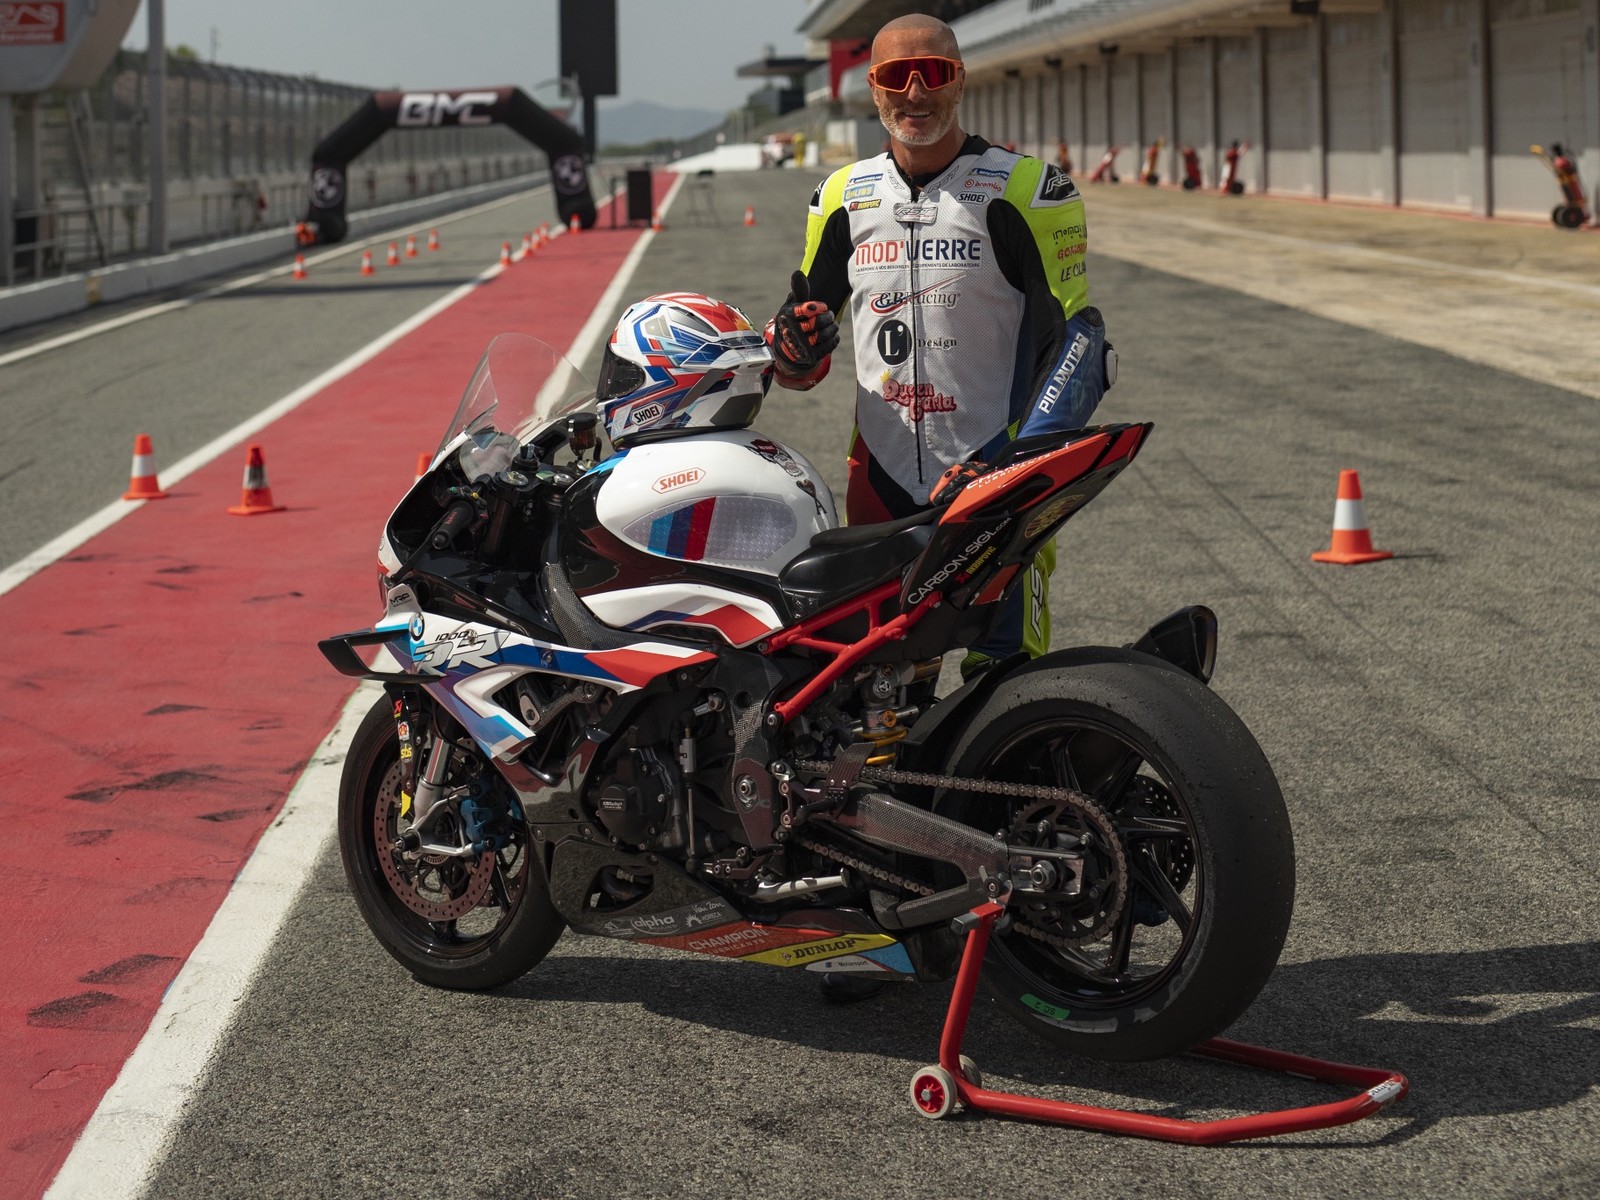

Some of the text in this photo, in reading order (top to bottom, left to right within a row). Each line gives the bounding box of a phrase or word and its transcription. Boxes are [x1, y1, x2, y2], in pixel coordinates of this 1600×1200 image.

[397, 92, 498, 125] BMC
[1044, 172, 1072, 195] RS
[958, 193, 985, 203] SHOEI
[918, 338, 957, 349] Design
[633, 405, 661, 424] SHOEI
[659, 469, 699, 491] SHOEI
[1029, 551, 1045, 642] RS
[634, 915, 675, 931] alpha
[688, 927, 770, 951] CHAMPION
[793, 936, 858, 960] DUNLOP
